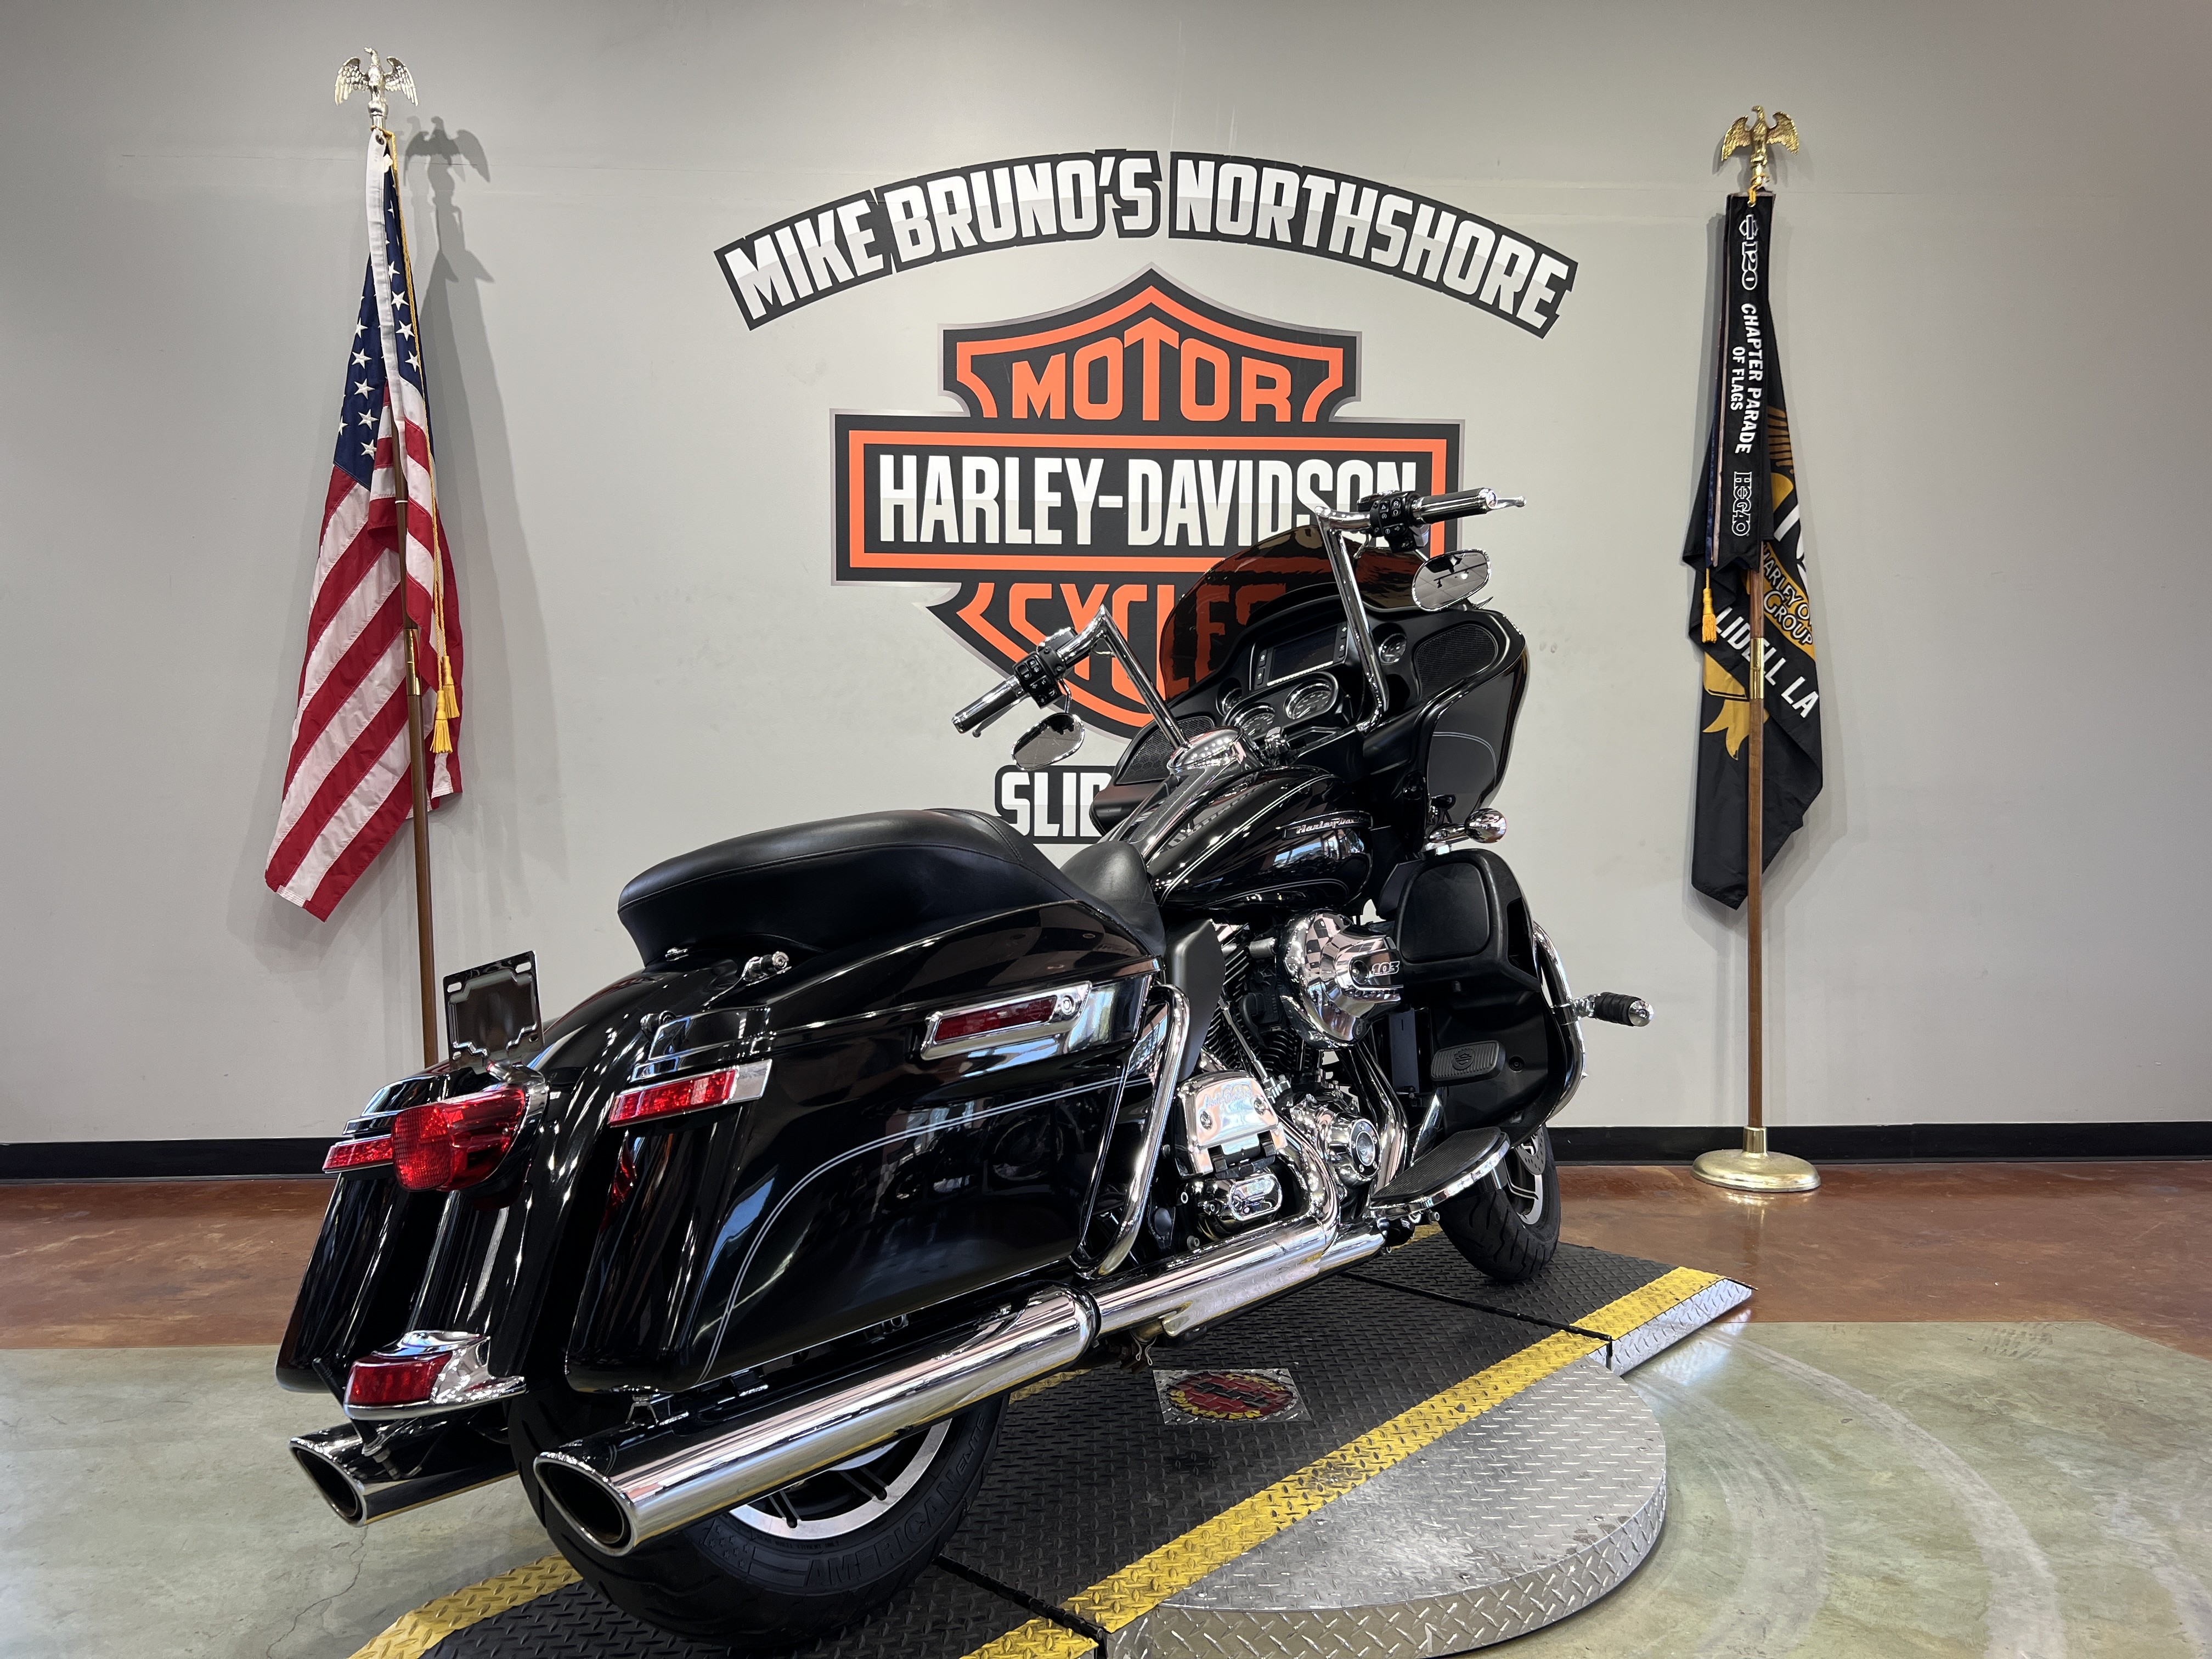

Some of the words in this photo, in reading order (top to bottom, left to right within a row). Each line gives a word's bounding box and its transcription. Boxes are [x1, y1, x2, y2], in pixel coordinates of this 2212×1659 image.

[723, 198, 887, 319] MIKE
[881, 156, 1156, 264] BRUNO'S
[1176, 157, 1569, 329] NORTHSHORE
[1733, 346, 1745, 364] OF
[1741, 302, 1763, 381] CHAPTER
[1012, 317, 1291, 422] MOTOR
[1729, 369, 1745, 411] FLAGS
[1735, 386, 1763, 454] PARADE
[1763, 590, 1813, 644] GROUP
[1781, 676, 1819, 718] LA
[1372, 961, 1400, 977] 103
